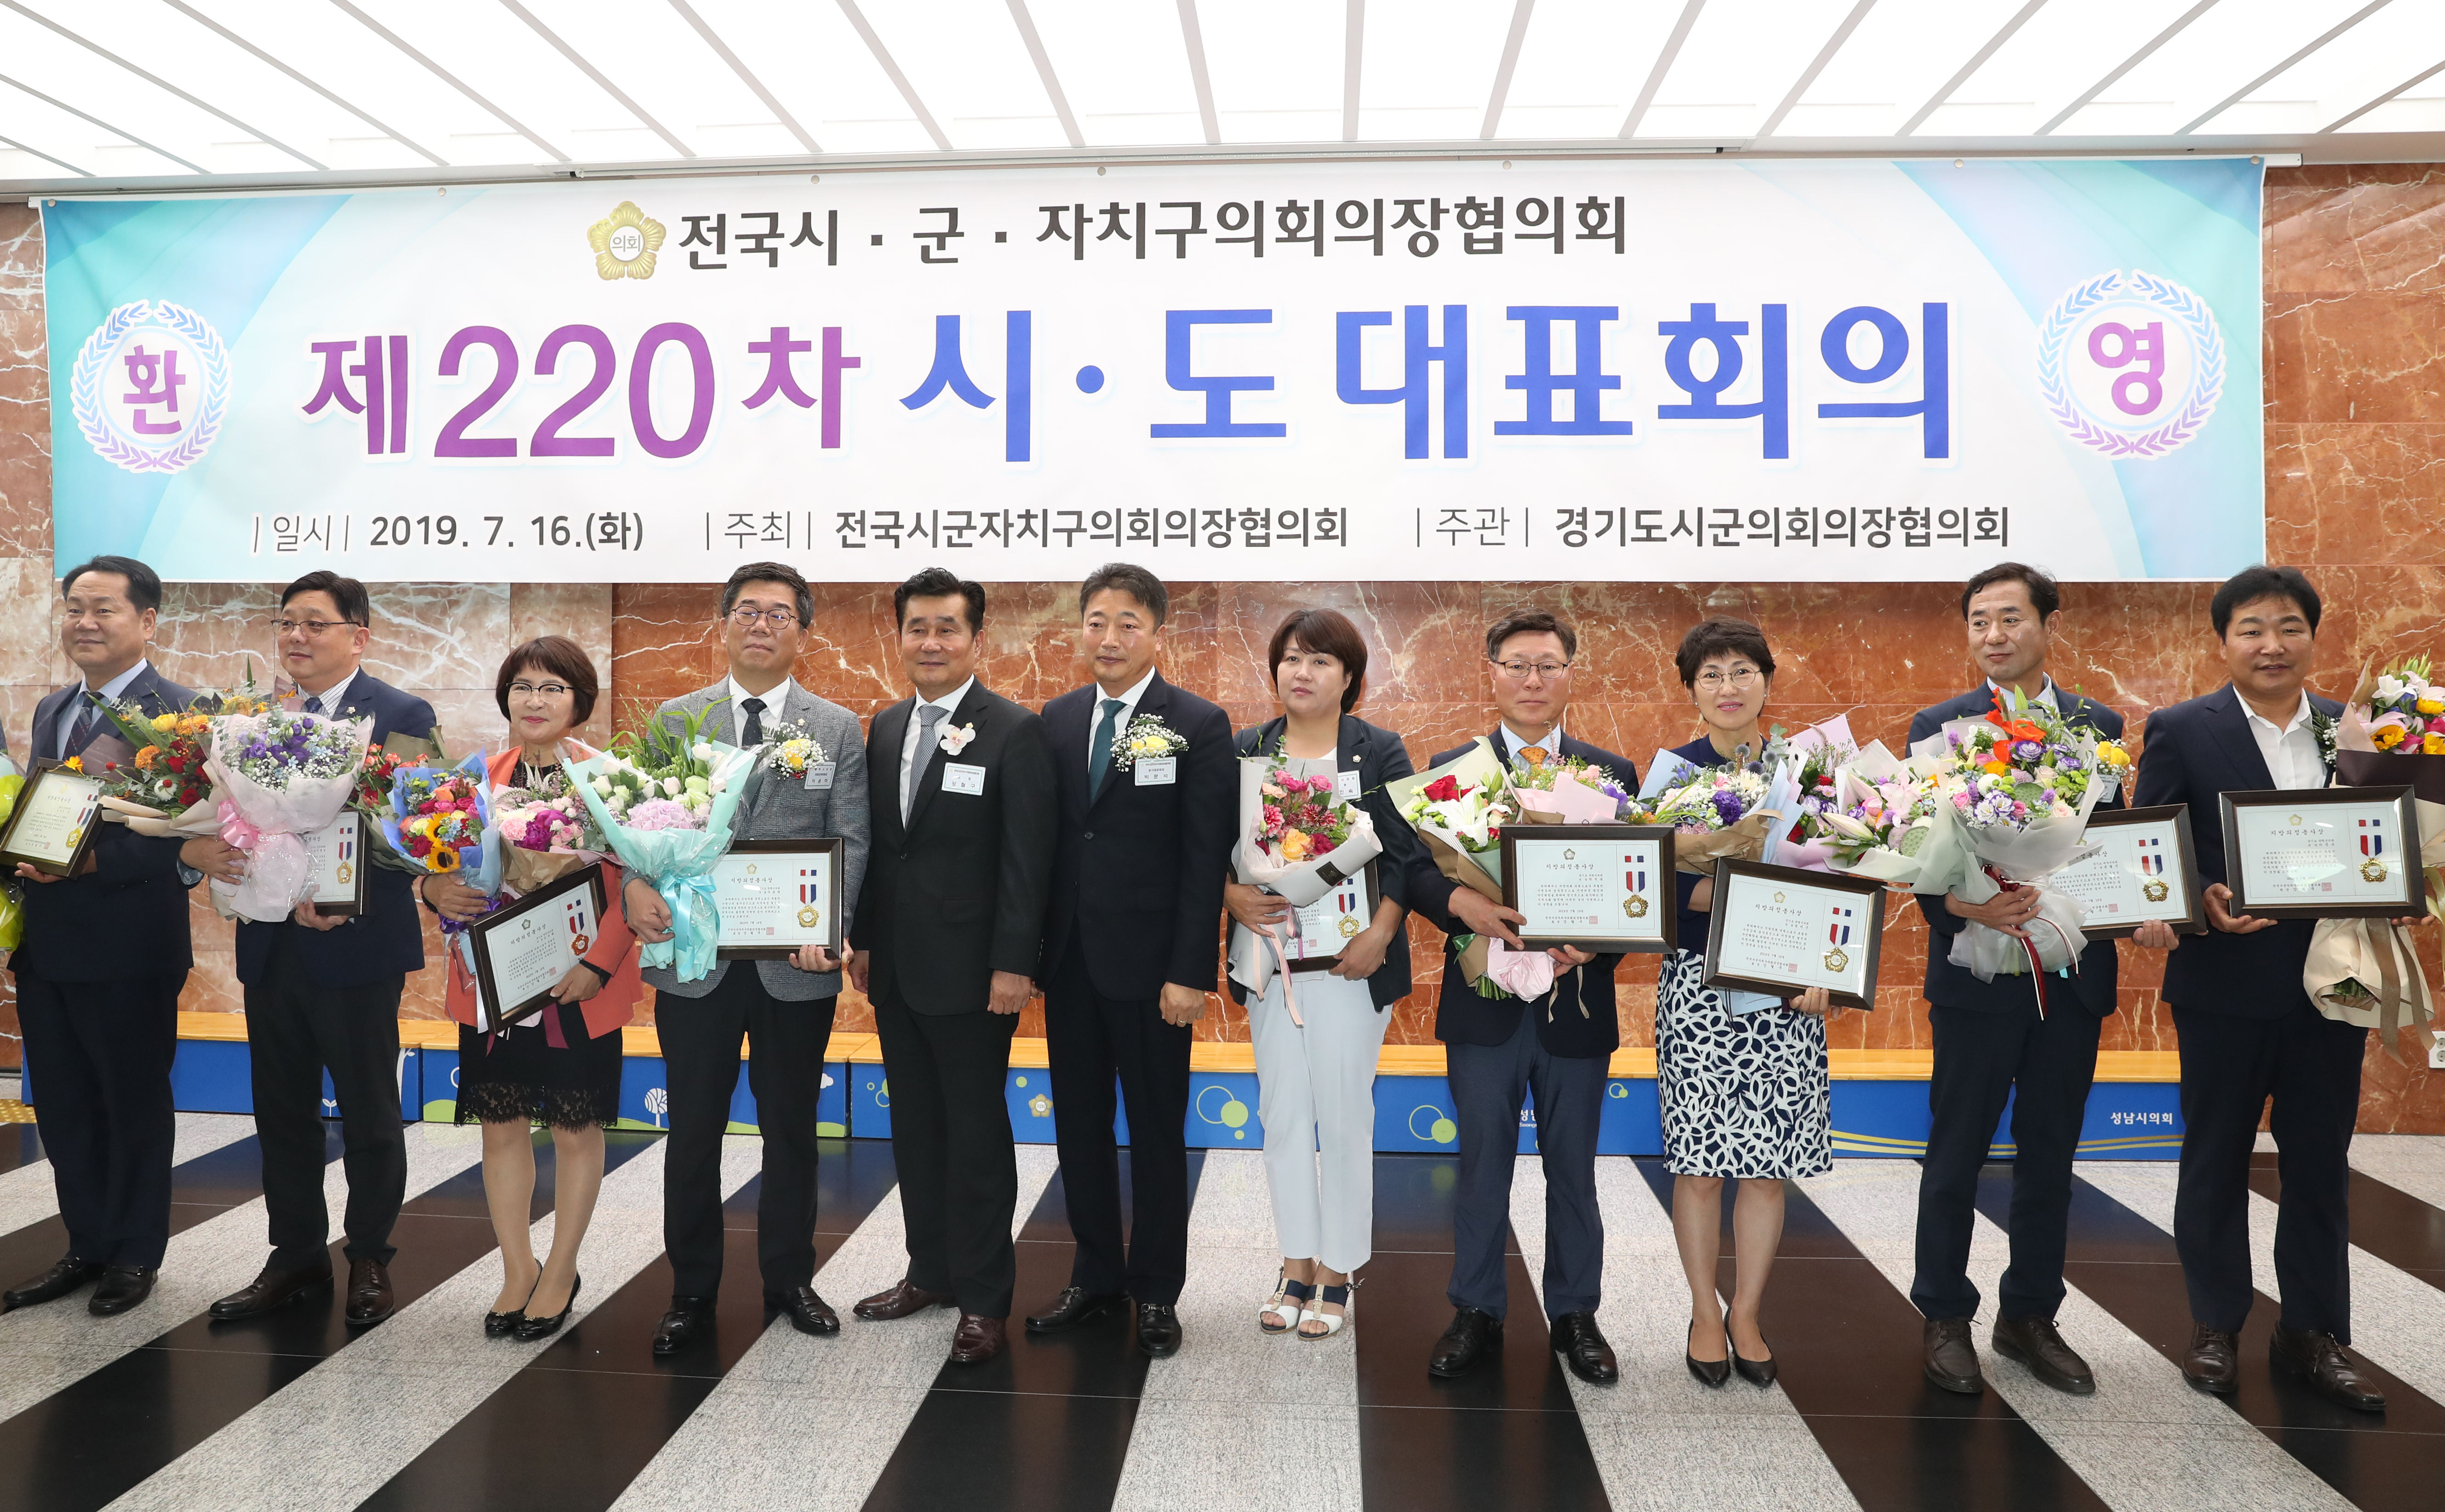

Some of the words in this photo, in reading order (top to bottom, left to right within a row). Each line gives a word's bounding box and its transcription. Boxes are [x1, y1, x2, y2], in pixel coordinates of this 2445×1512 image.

[612, 235, 640, 252] 의회
[680, 210, 837, 269] 전국시
[913, 208, 964, 263] 군
[1037, 196, 1624, 260] 자치구의회의장협의회
[304, 323, 860, 458] 제220차
[1337, 303, 1948, 458] 대표회의
[2090, 323, 2164, 414] 영
[126, 351, 180, 433] 환
[371, 515, 468, 547] 2019.
[484, 516, 513, 547] 7.
[532, 512, 643, 551] 16.(화)
[836, 508, 1346, 549] 전국시군자치구의회의장협의회
[1556, 507, 2008, 548] 경기도시군의회의장협의회
[1755, 904, 1801, 916] 지방의정봉사상
[2110, 1112, 2172, 1125] 성남시의회
